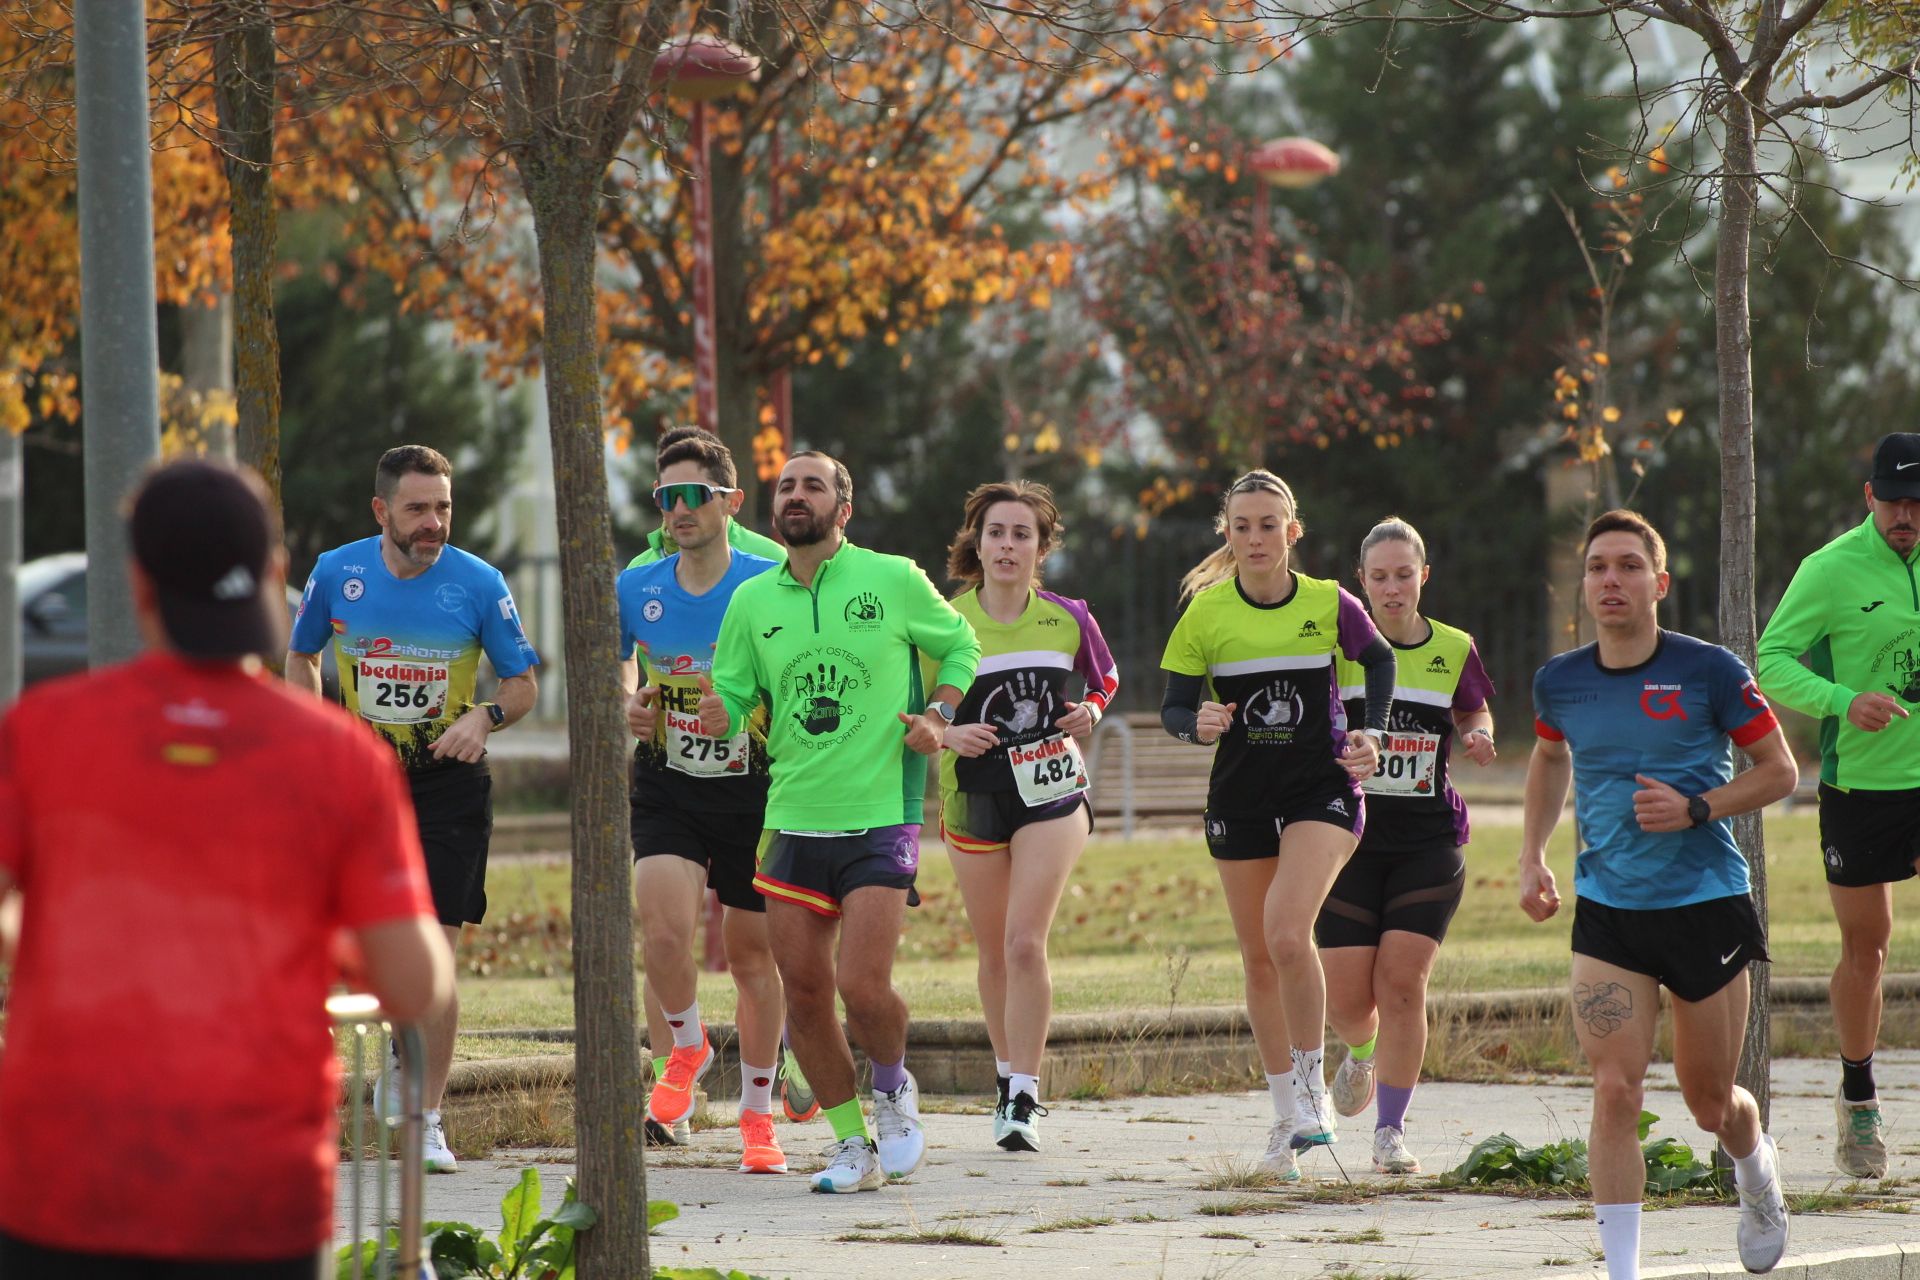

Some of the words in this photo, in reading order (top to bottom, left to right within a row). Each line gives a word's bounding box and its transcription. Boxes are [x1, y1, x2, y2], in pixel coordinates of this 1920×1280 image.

[360, 661, 447, 682] bedunia
[376, 682, 429, 708] 256
[680, 735, 730, 761] 275
[788, 723, 814, 749] CNTRO
[1034, 753, 1077, 786] 482
[1373, 753, 1417, 779] 301
